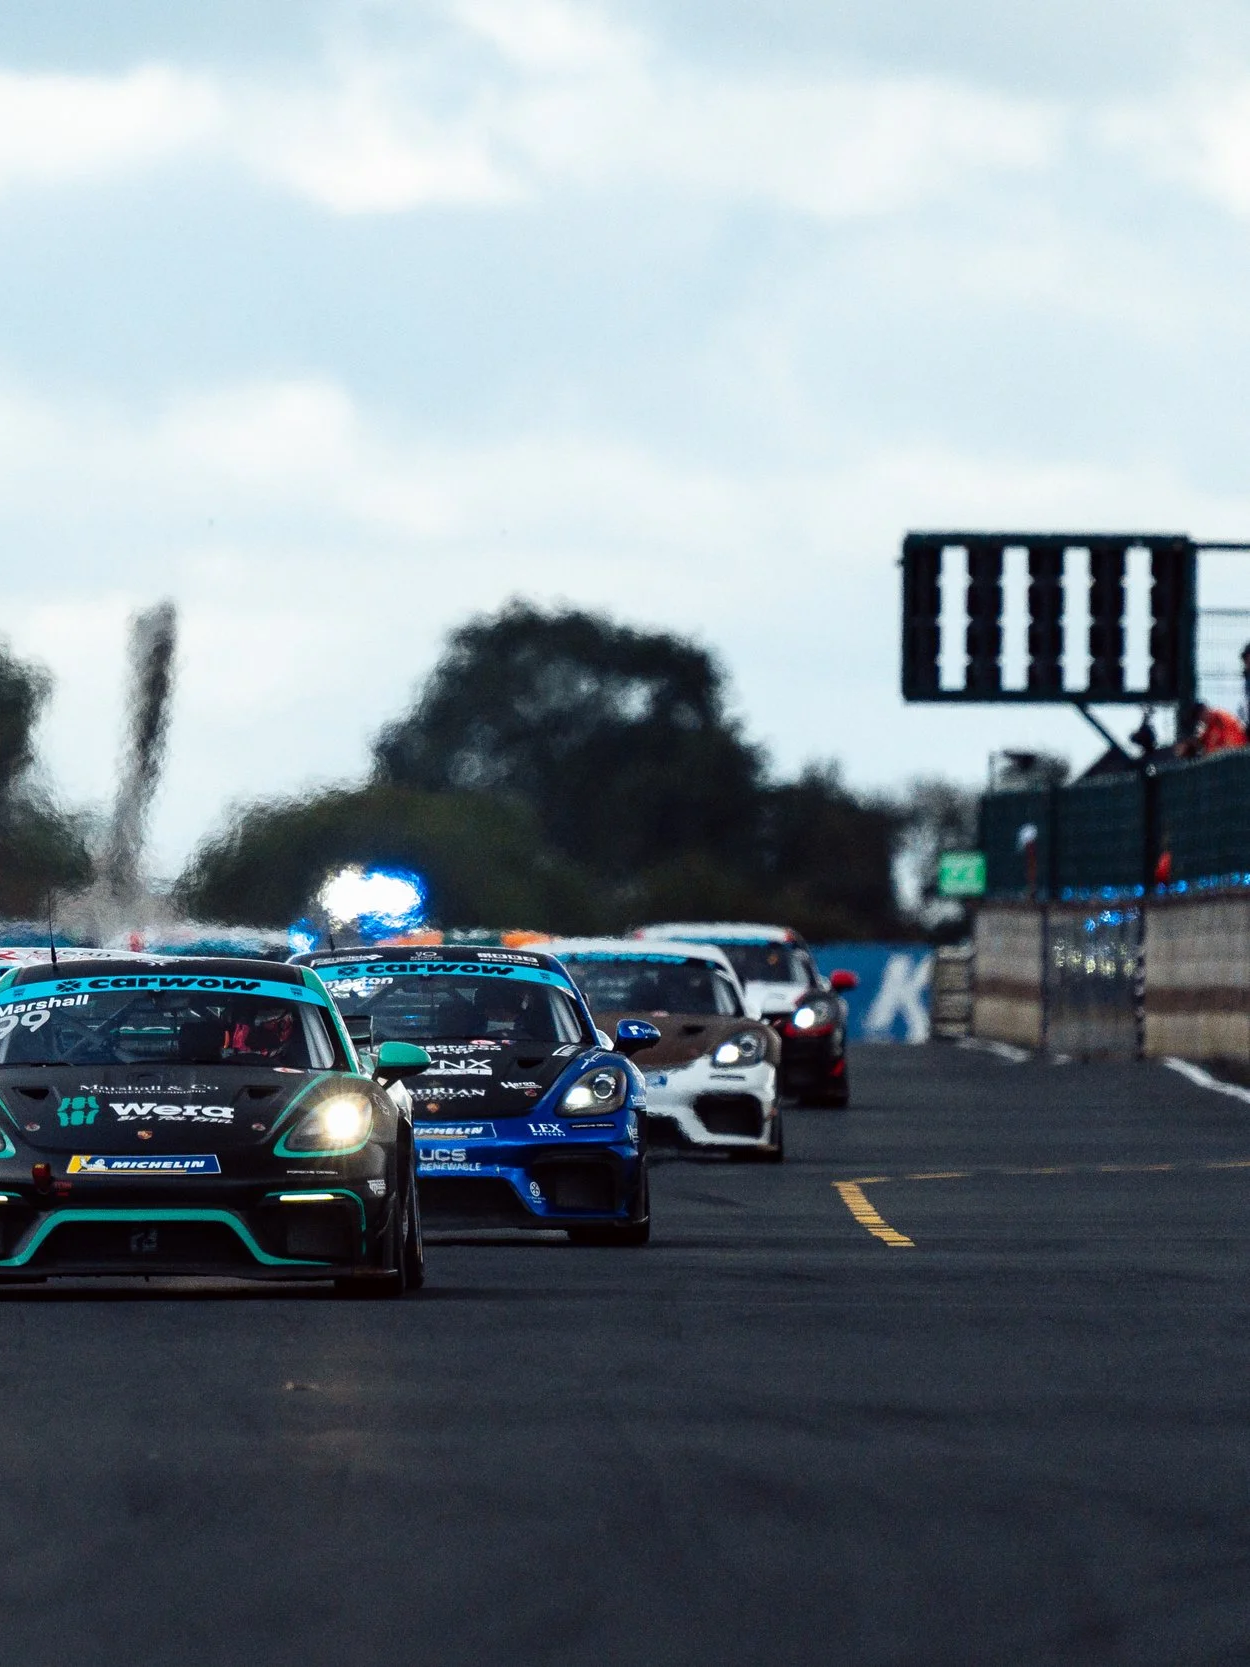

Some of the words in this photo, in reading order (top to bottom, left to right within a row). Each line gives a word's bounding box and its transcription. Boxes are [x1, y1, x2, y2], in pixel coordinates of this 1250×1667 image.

[366, 963, 514, 975] carwow
[88, 976, 261, 991] carwow
[109, 1102, 235, 1119] Wera
[527, 1123, 565, 1133] LEX
[419, 1148, 467, 1161] UCS
[111, 1161, 205, 1169] MICHELIN
[419, 1162, 482, 1172] RENEWABLE
